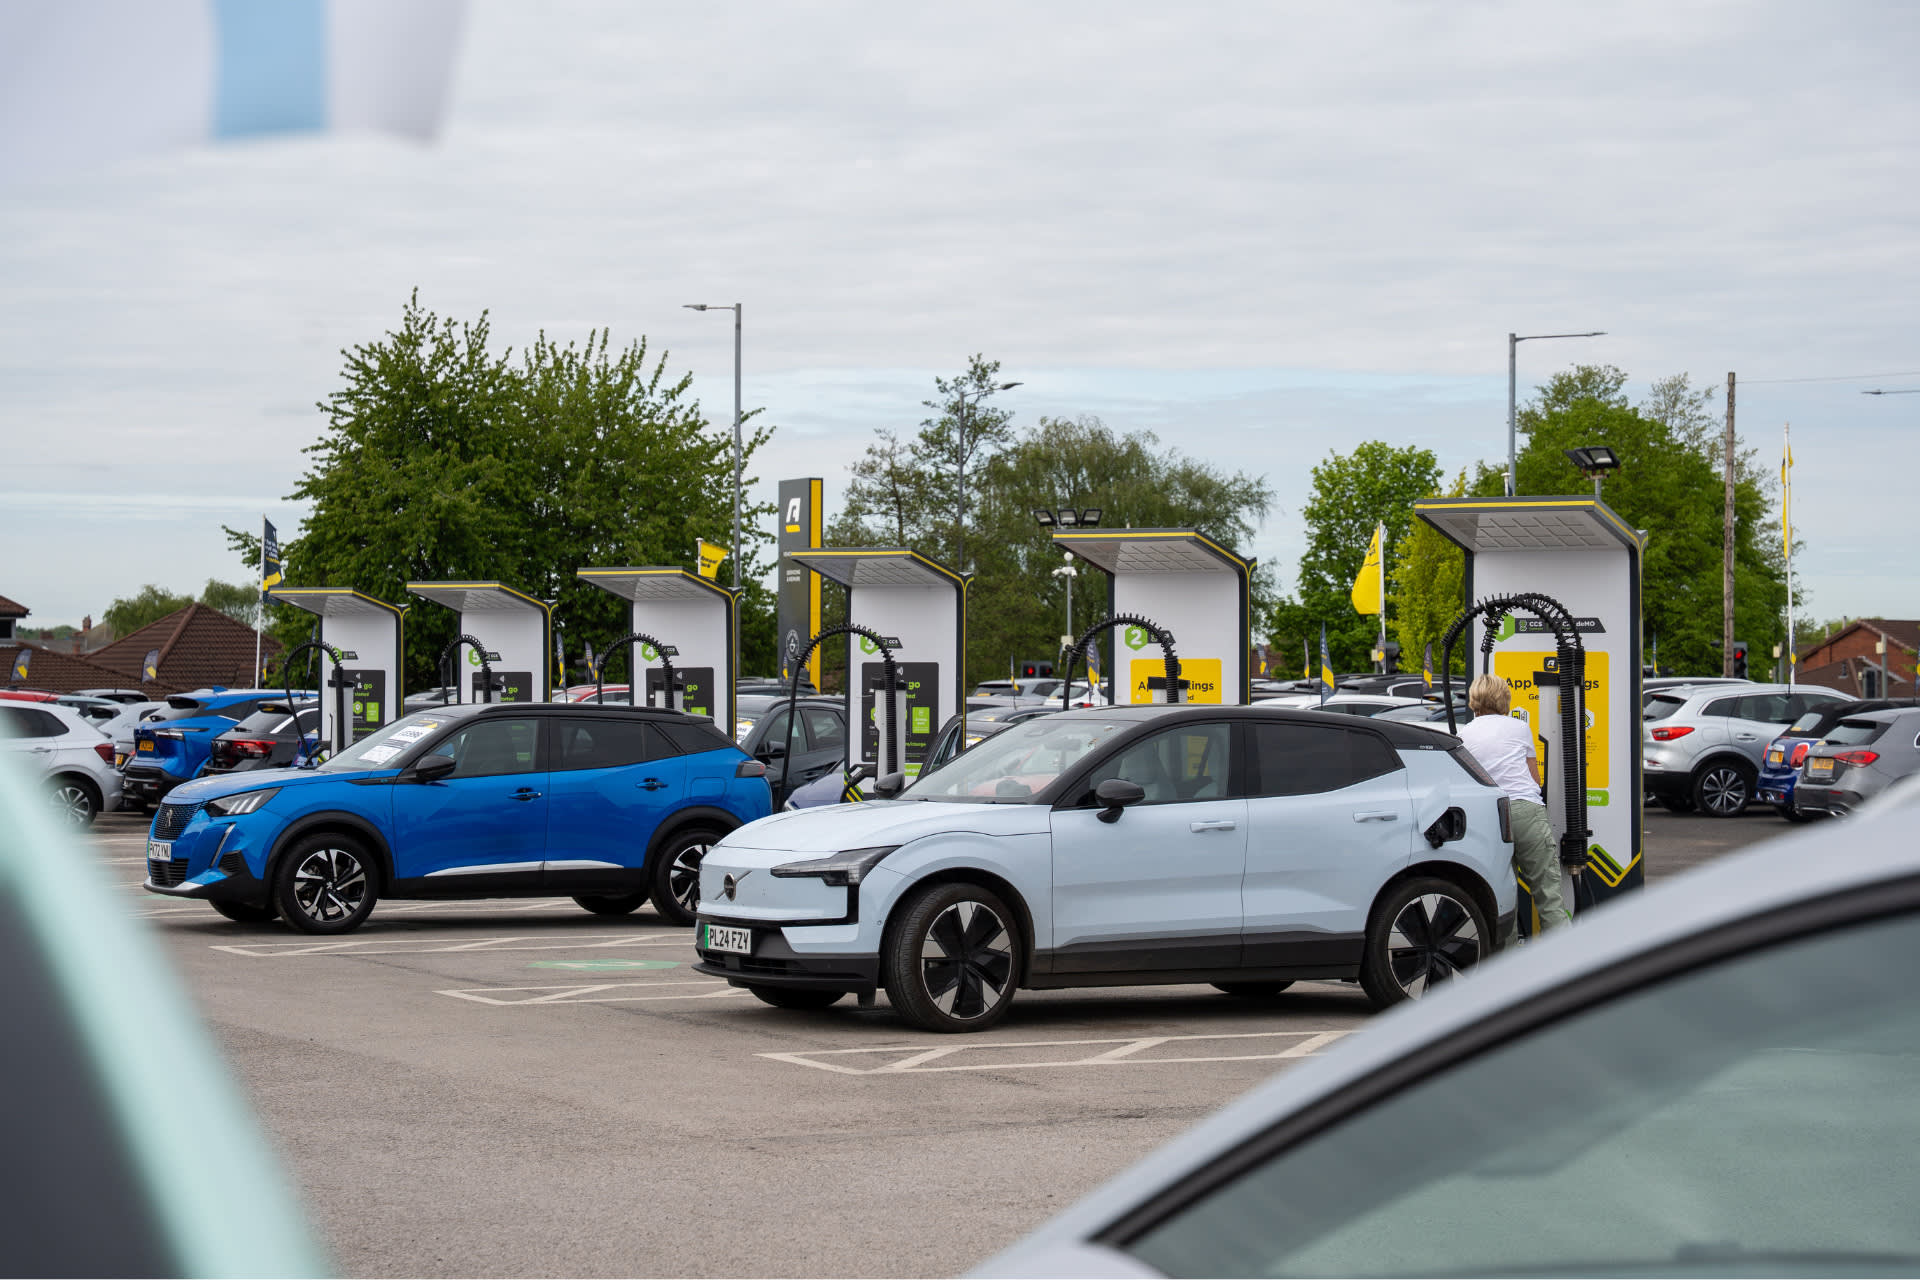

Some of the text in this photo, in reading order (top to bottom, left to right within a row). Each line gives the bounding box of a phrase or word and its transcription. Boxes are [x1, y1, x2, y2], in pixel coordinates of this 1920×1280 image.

[1130, 630, 1142, 644] 2
[908, 682, 920, 690] go
[1506, 677, 1532, 690] App
[709, 928, 749, 950] PL24 FZY
